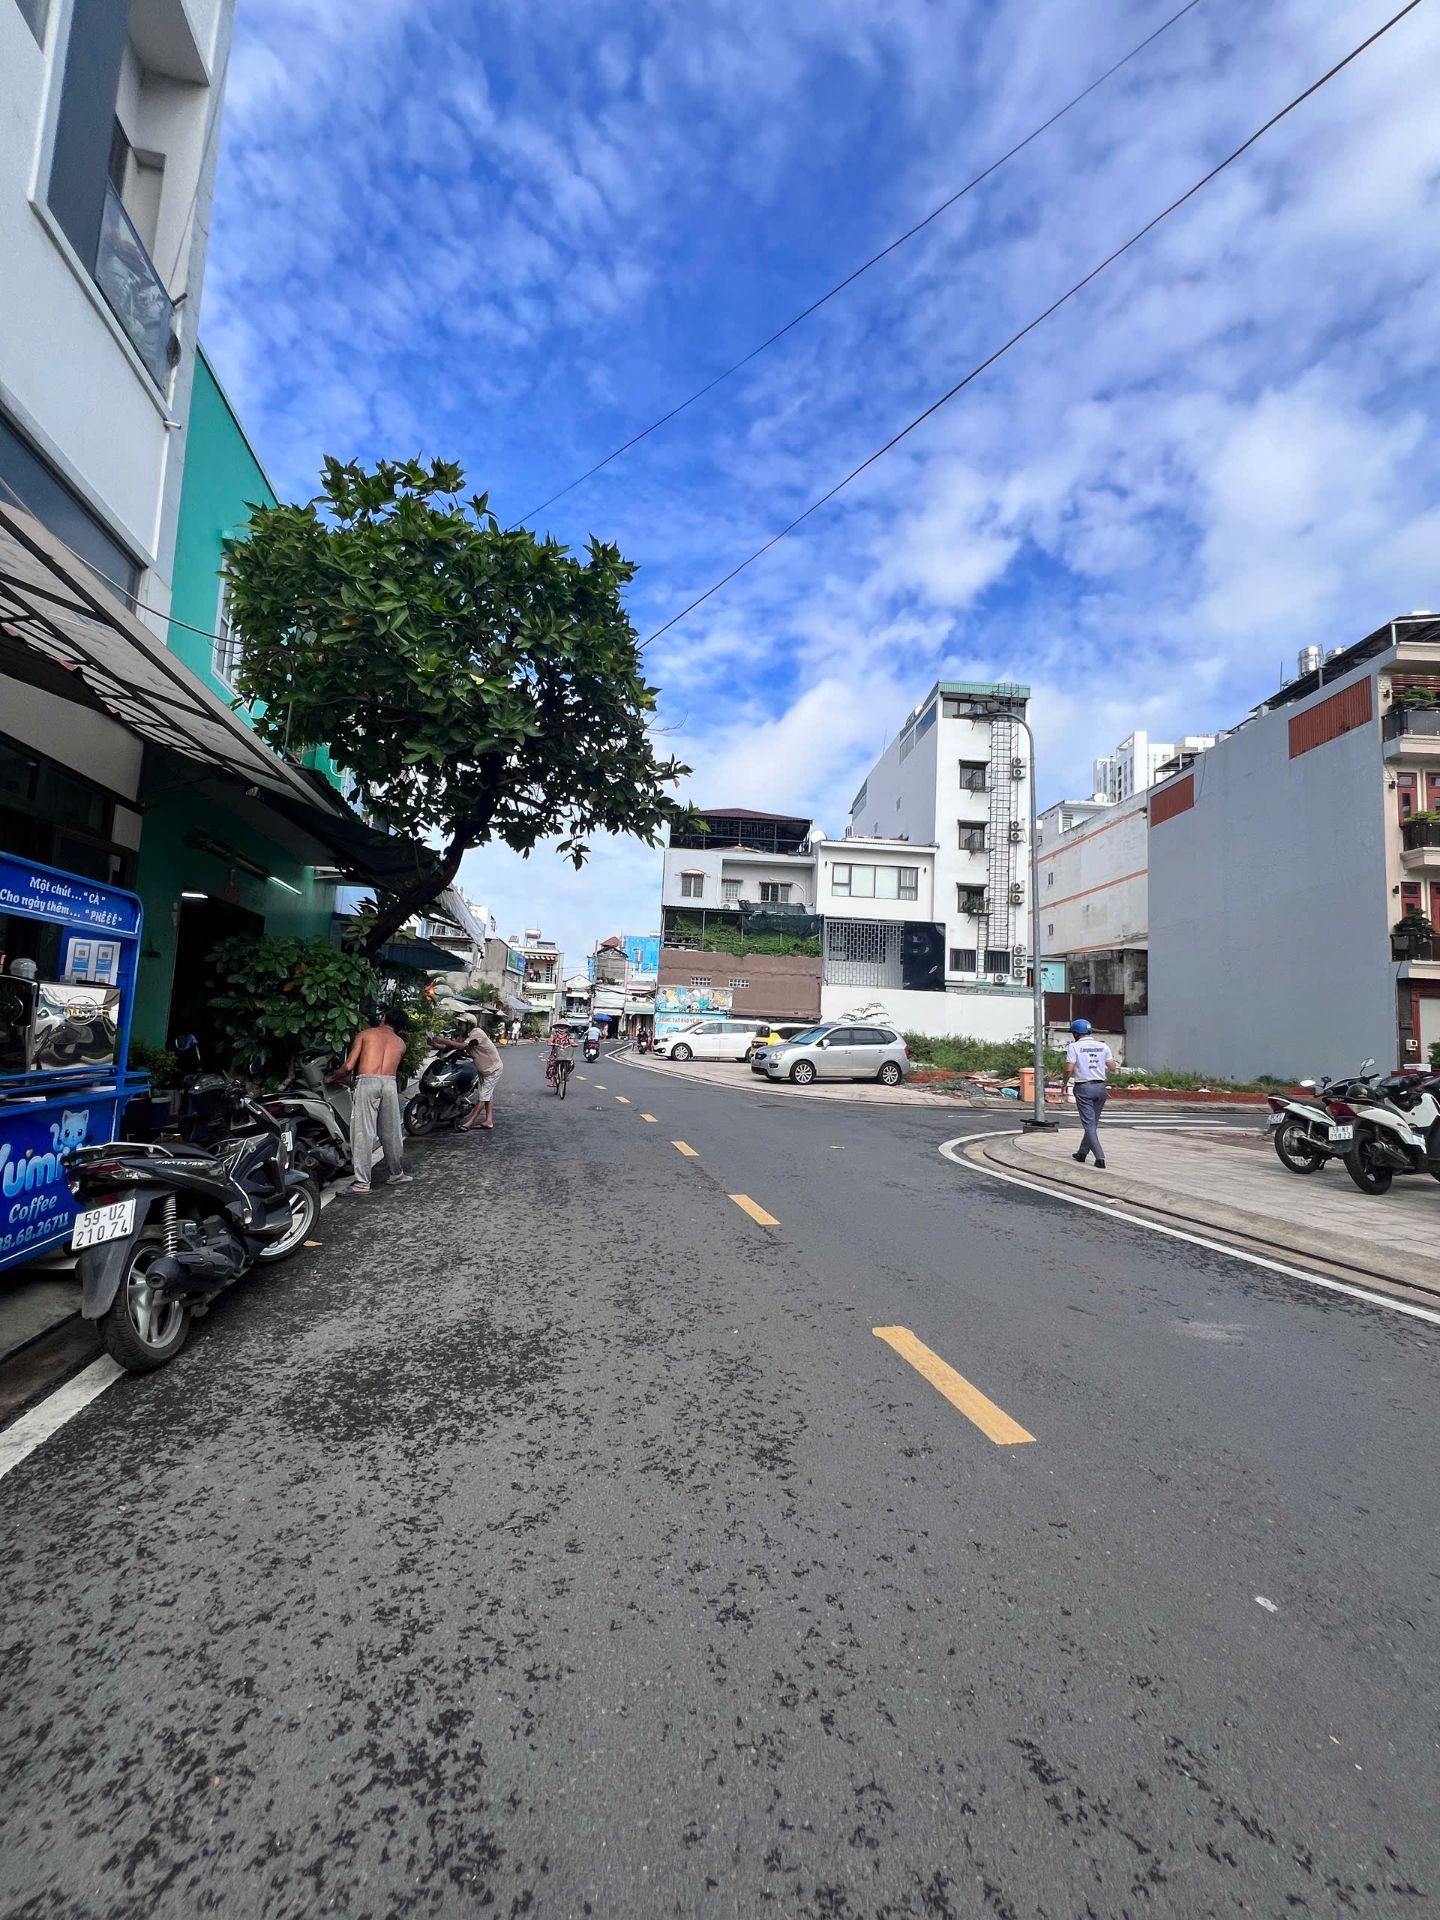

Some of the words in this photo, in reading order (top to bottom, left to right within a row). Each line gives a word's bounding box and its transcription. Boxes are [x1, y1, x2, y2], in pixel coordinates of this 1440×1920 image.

[29, 877, 50, 894] Một
[0, 888, 20, 904] Cho
[21, 896, 46, 912] ngày
[8, 1195, 58, 1224] Coffee
[83, 1203, 126, 1228] 59-U2
[75, 1219, 128, 1248] 210.74
